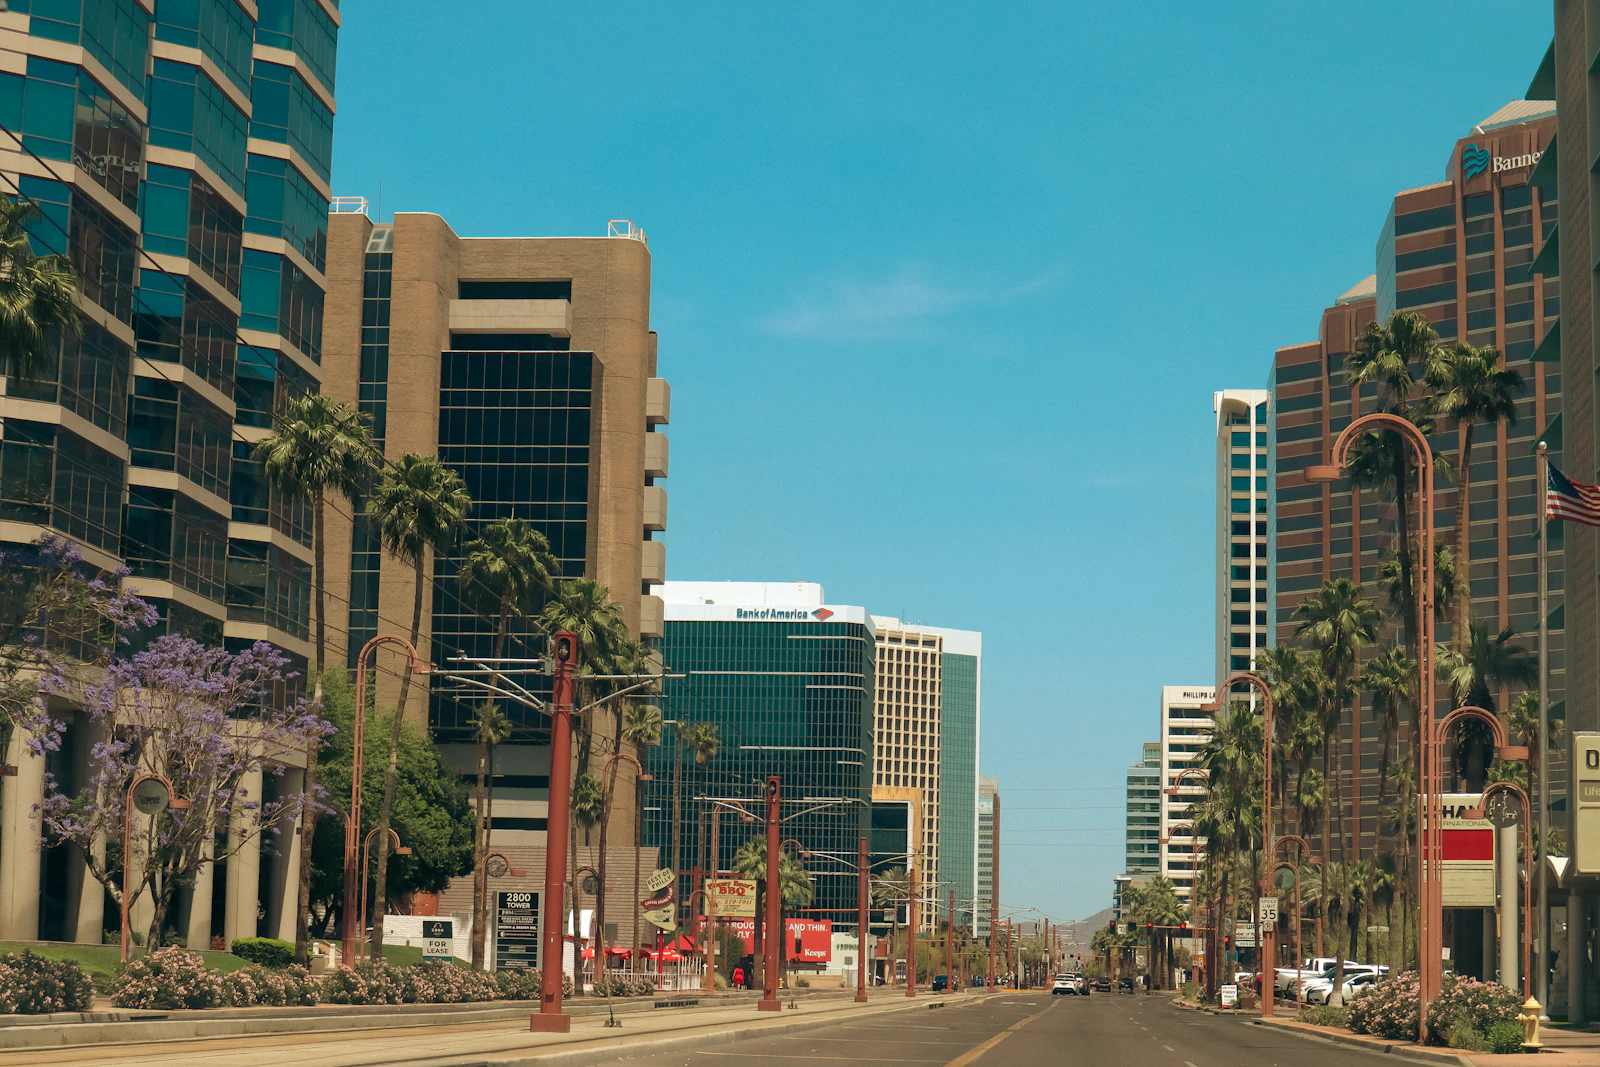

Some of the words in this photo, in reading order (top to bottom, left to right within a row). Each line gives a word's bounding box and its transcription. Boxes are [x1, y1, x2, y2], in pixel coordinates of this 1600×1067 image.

[736, 608, 760, 619] Bank
[760, 608, 769, 619] of
[770, 608, 808, 619] America
[647, 873, 662, 886] BEST
[662, 869, 670, 877] OF
[651, 875, 671, 889] PHILLY
[506, 892, 531, 902] 2800
[719, 886, 745, 897] BBQ
[1261, 909, 1276, 920] 35
[789, 923, 806, 931] AND
[807, 924, 828, 932] THIN.
[804, 948, 827, 958] Keeps
